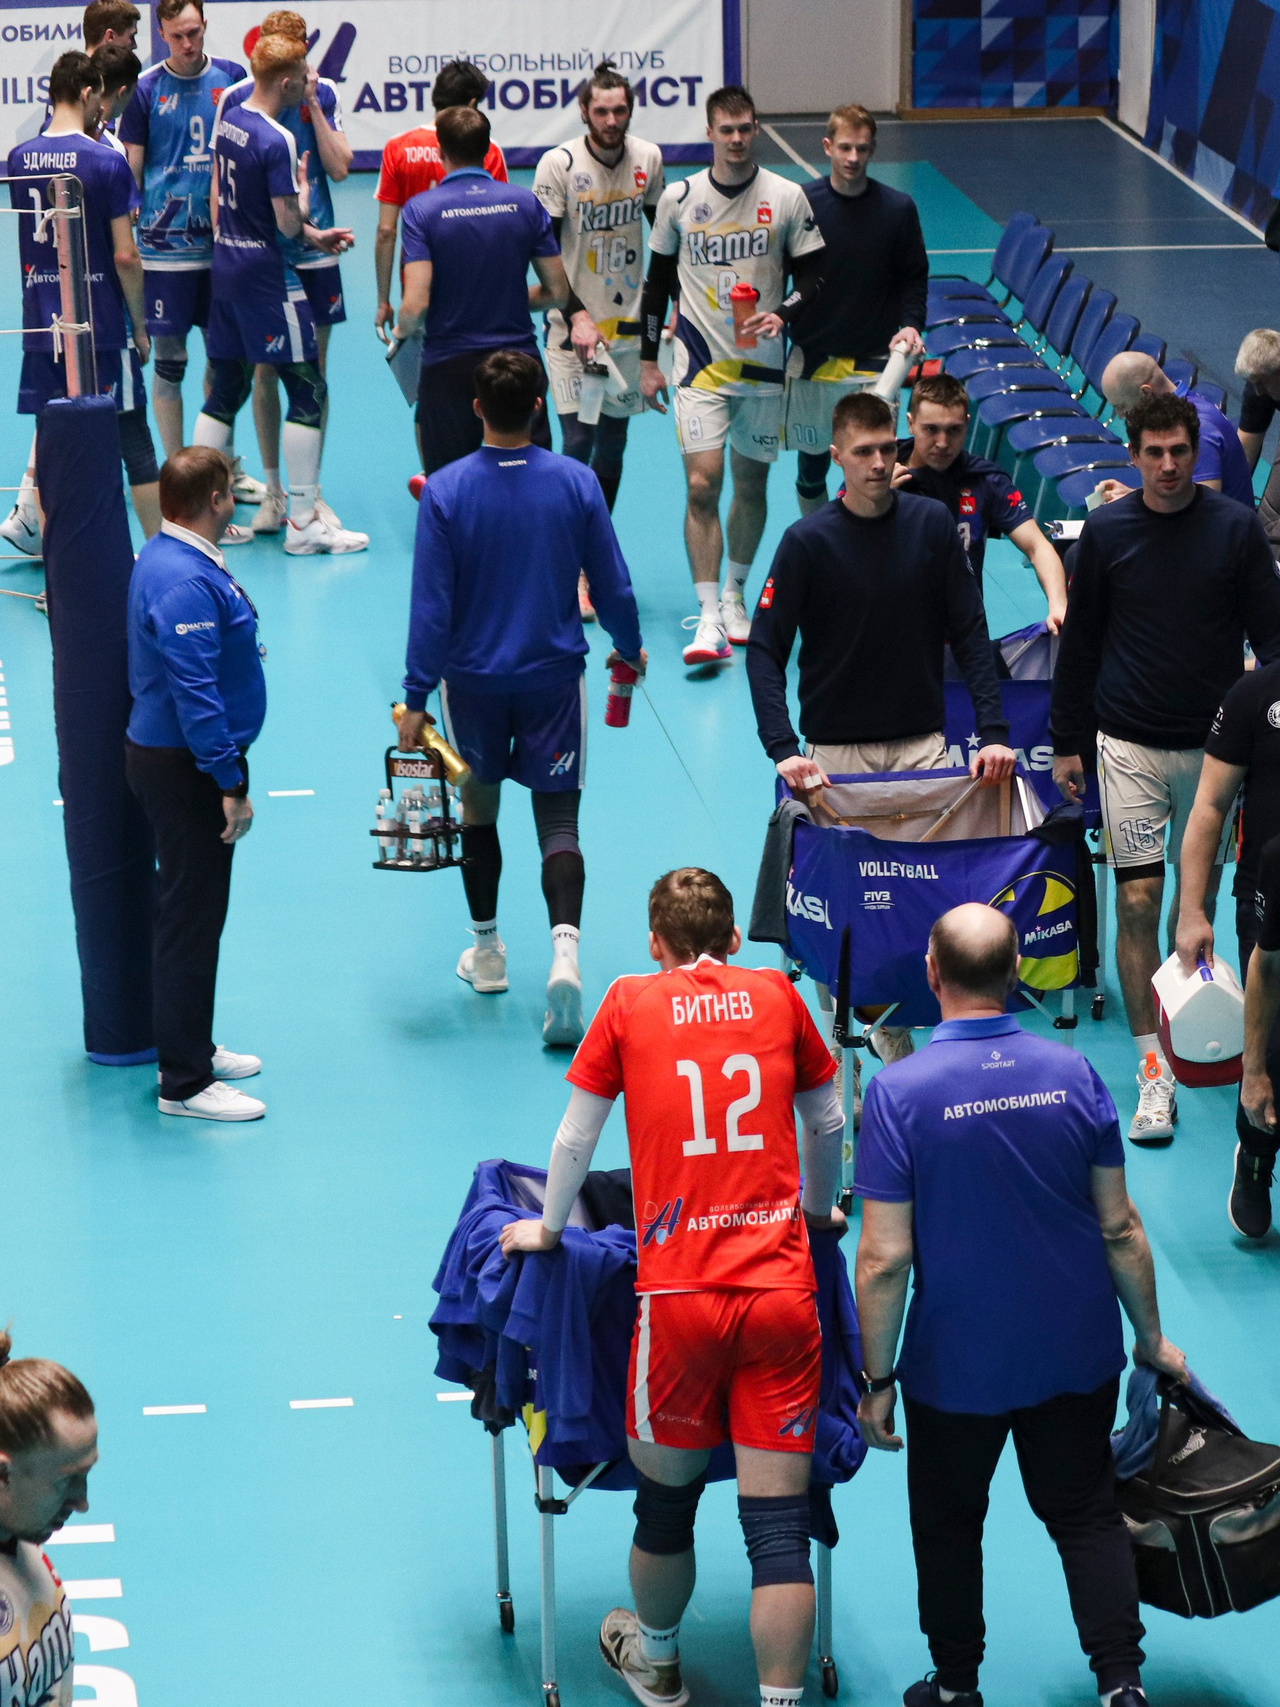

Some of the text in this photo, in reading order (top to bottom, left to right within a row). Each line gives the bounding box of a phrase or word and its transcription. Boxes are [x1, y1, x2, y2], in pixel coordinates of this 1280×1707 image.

[189, 115, 205, 154] 9
[23, 151, 78, 171] УДИНЦЕВ
[440, 203, 519, 220] АВТОМОБИЛИСТ
[591, 235, 628, 275] 16
[687, 227, 770, 267] Kama
[154, 298, 164, 319] 9
[396, 759, 434, 778] isostar
[1118, 817, 1156, 853] 15
[858, 860, 939, 880] VOLLEYBALL
[864, 890, 892, 901] FIVB
[671, 990, 754, 1026] БИТНЕВ
[981, 1059, 1016, 1070] SPORTART
[676, 1053, 765, 1158] 12
[943, 1089, 1067, 1121] АВТОМОБИЛИСТ
